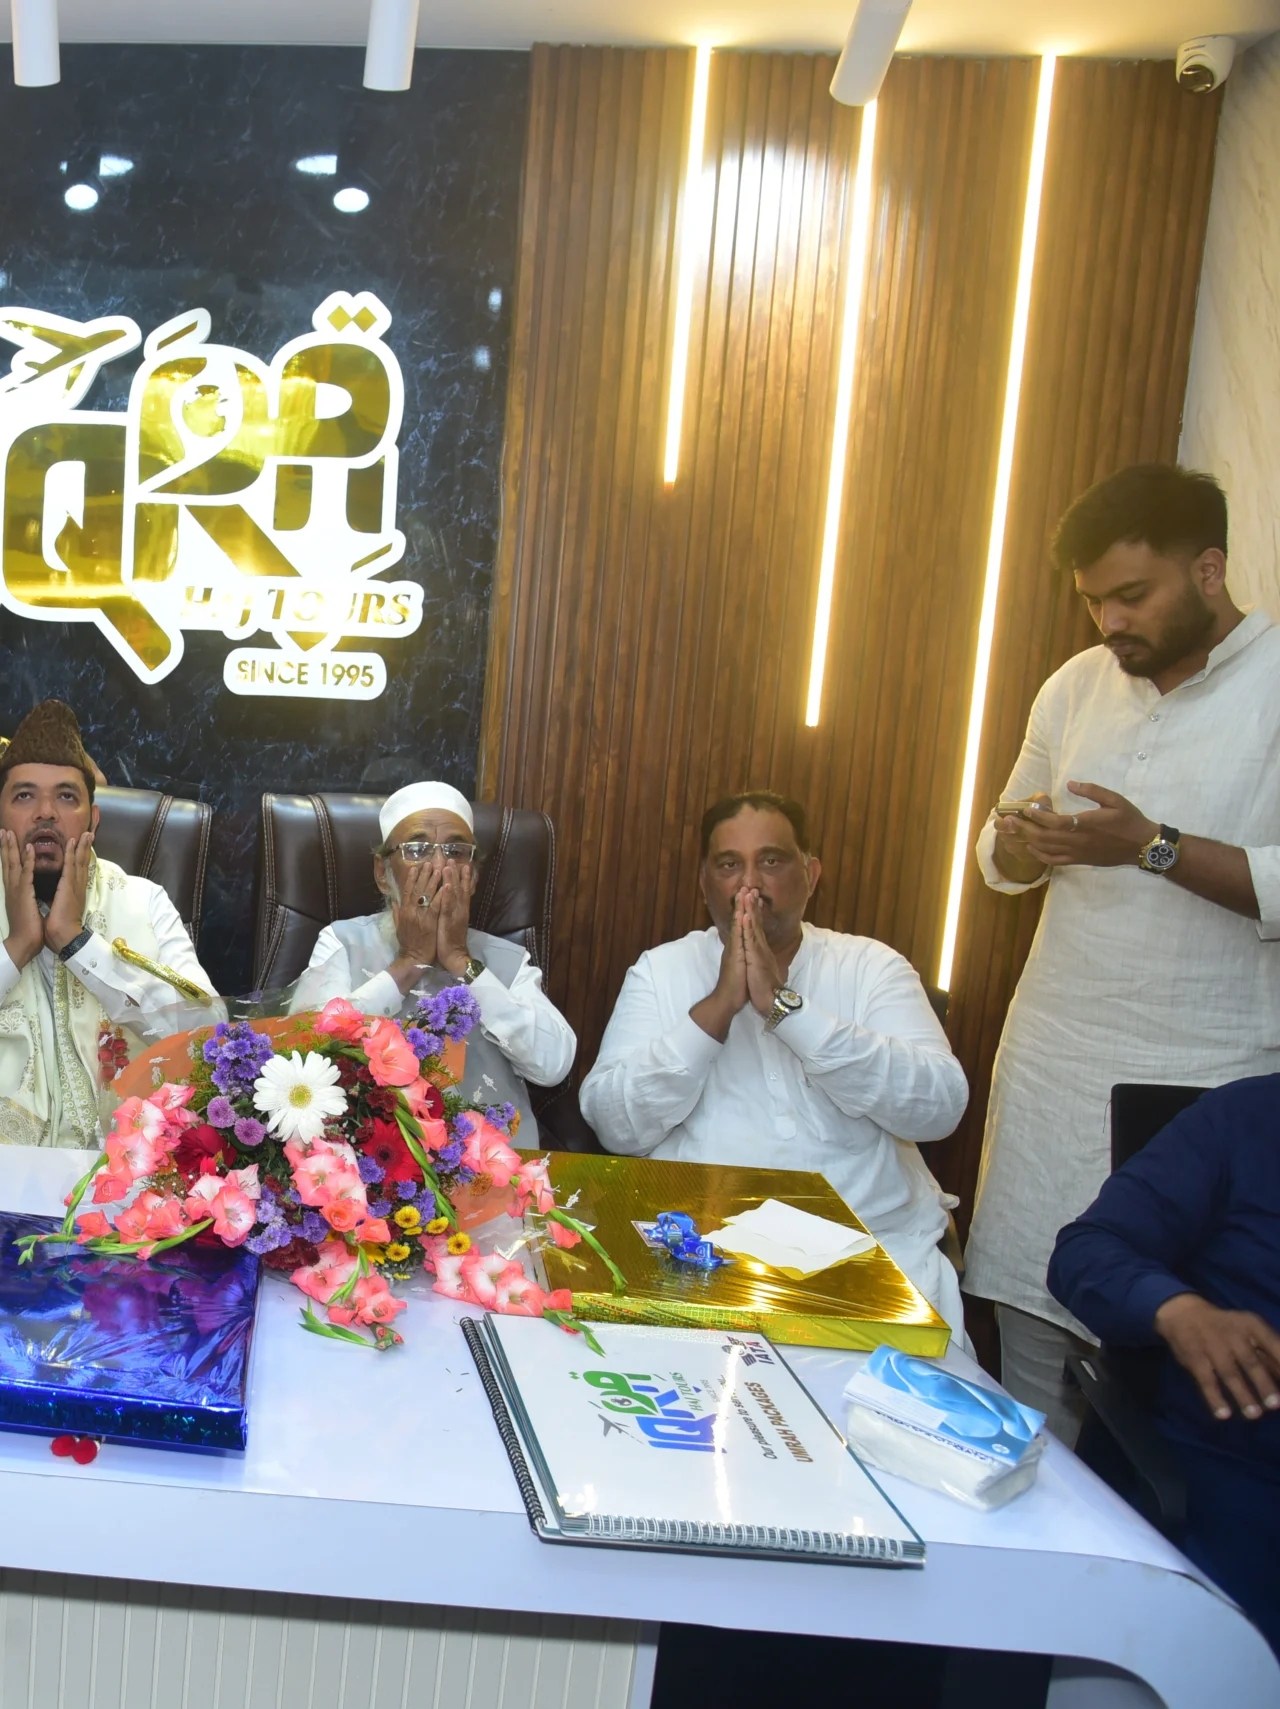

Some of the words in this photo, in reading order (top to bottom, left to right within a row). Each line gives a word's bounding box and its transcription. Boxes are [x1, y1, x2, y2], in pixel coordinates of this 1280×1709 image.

[180, 585, 255, 629] HJ
[236, 659, 309, 686] SINCE
[320, 662, 375, 688] 1995
[745, 1341, 776, 1365] IATA
[737, 1408, 750, 1416] to
[743, 1381, 790, 1427] PACKAGES
[742, 1416, 772, 1446] pleasure
[775, 1428, 814, 1463] UMRAH
[761, 1445, 778, 1460] Our
